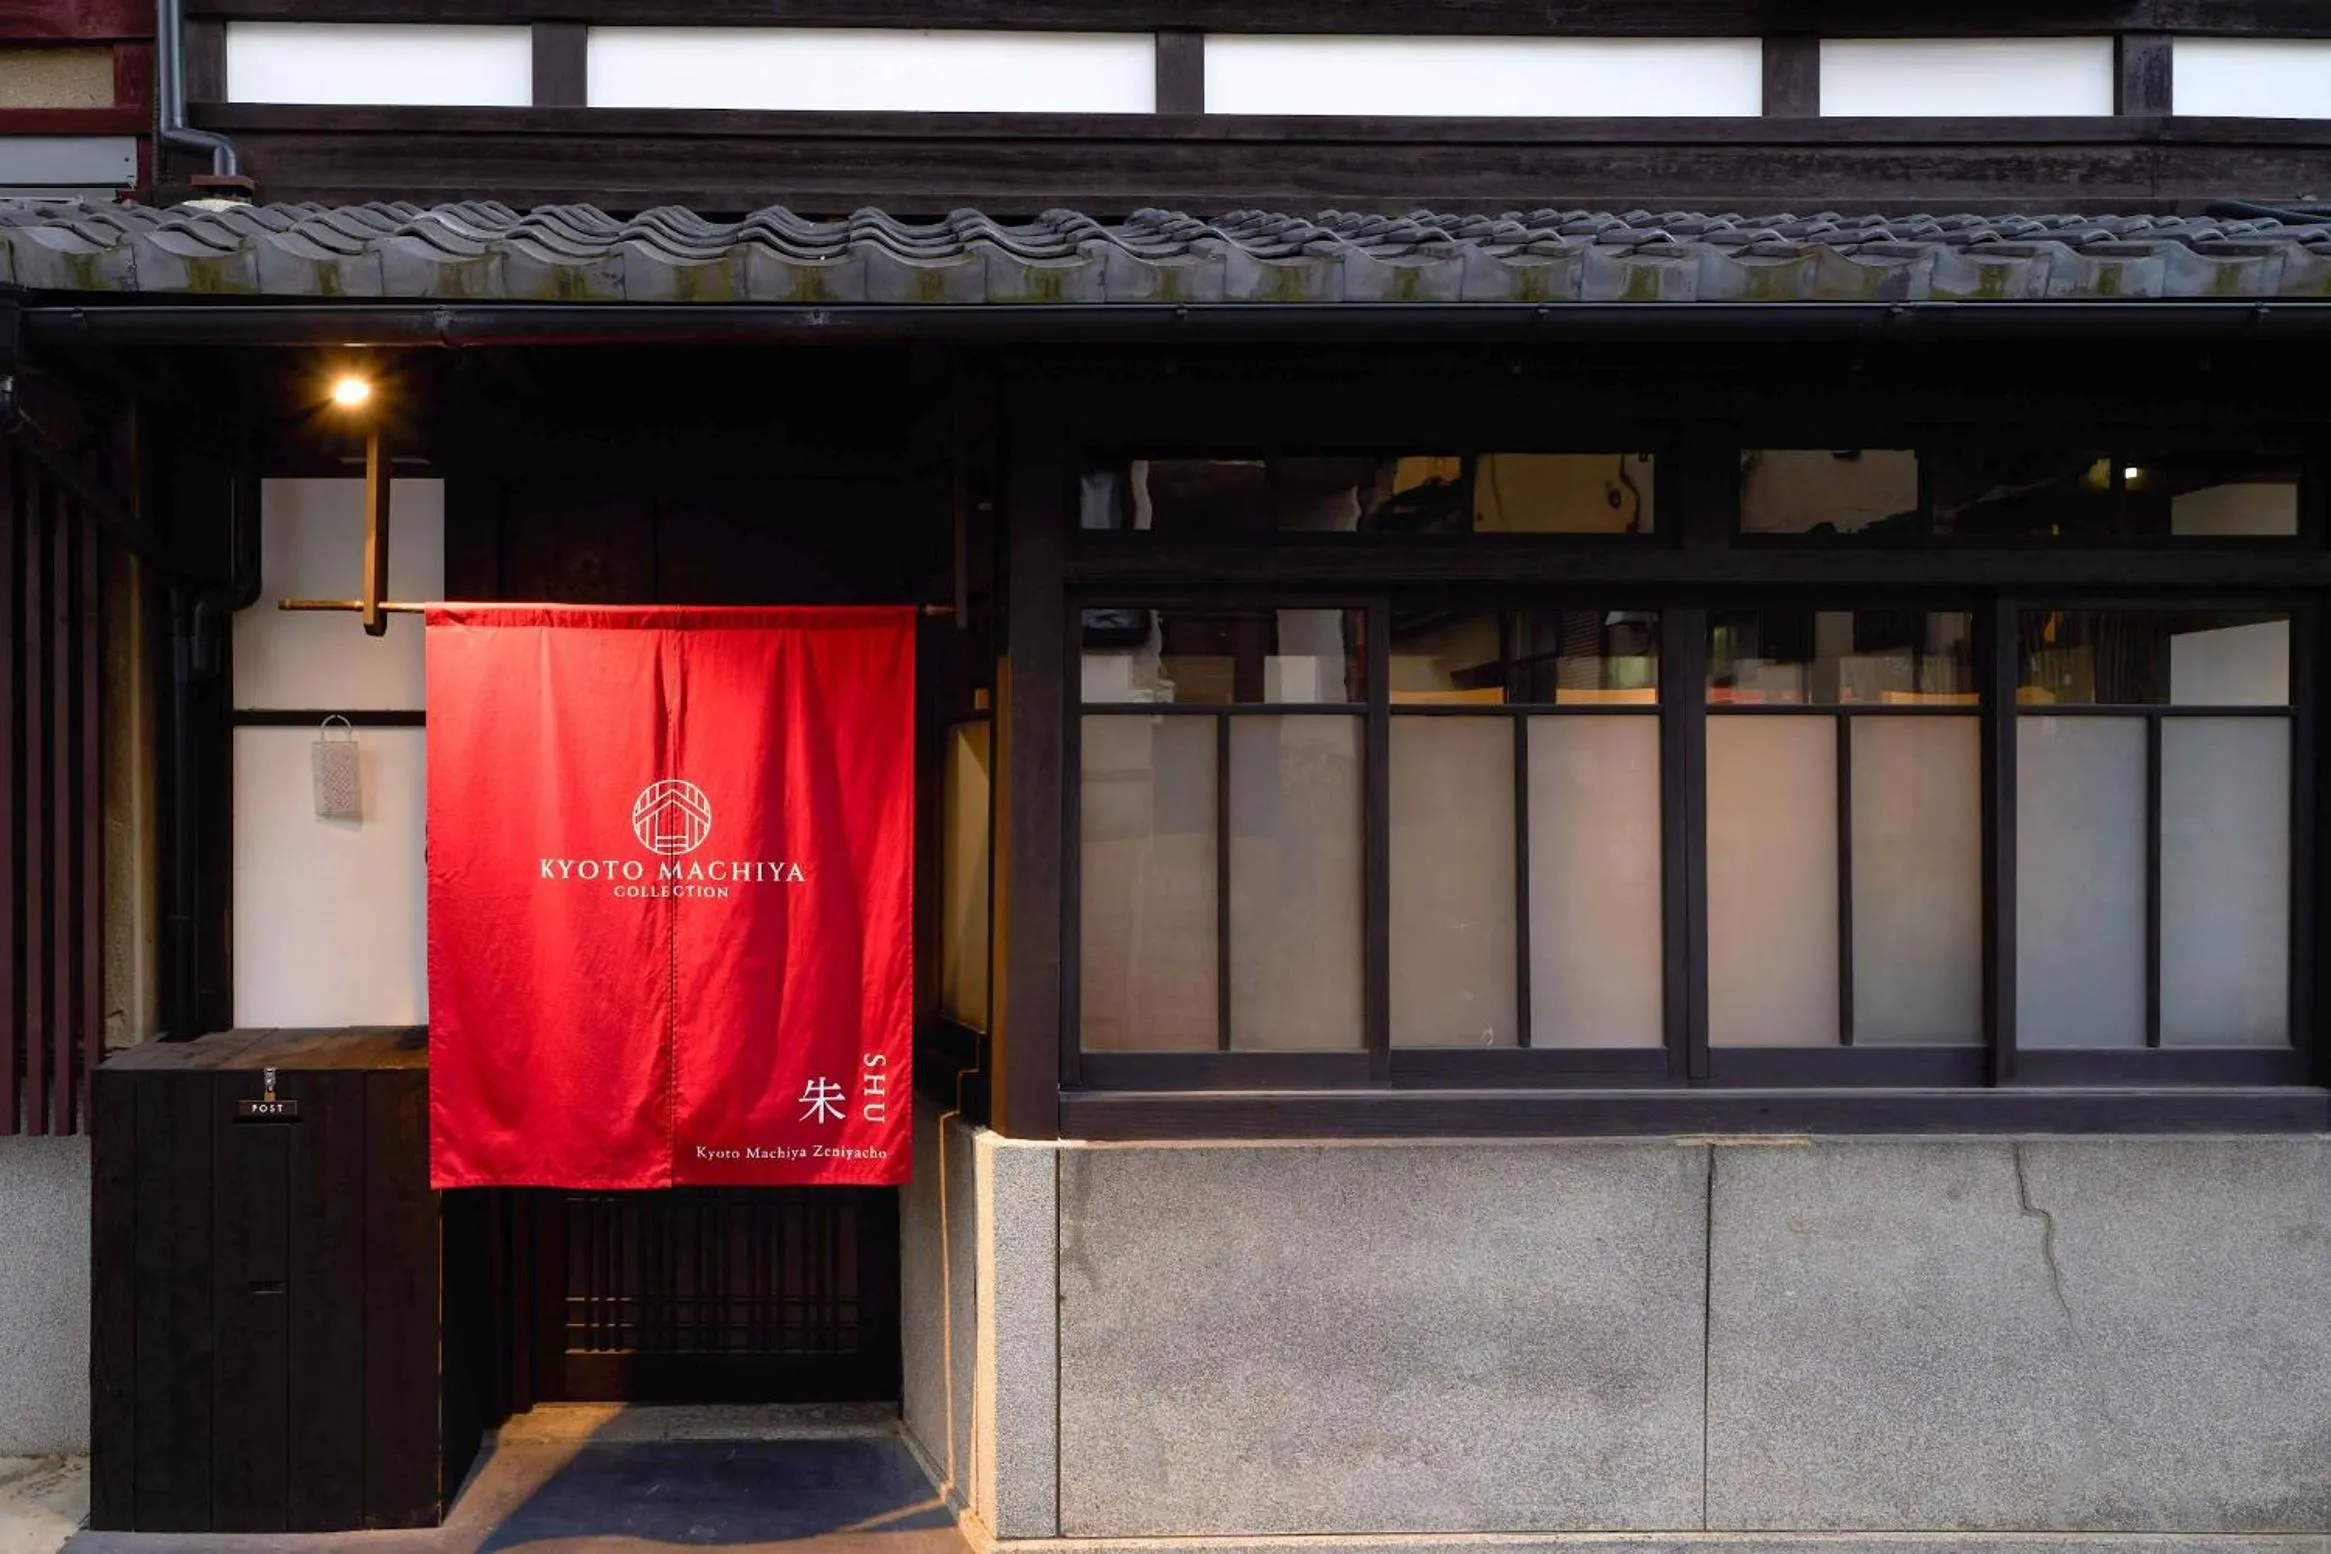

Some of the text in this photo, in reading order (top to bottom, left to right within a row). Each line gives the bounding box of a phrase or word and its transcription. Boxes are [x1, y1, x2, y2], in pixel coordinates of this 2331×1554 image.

[540, 859, 805, 882] KYOTO MACHIYA
[613, 885, 729, 898] COLLECTION
[863, 1053, 887, 1123] SHU
[251, 1104, 284, 1113] POST
[798, 1076, 846, 1124] 朱
[696, 1145, 888, 1161] Kyoto Machiya Zeniyacho
